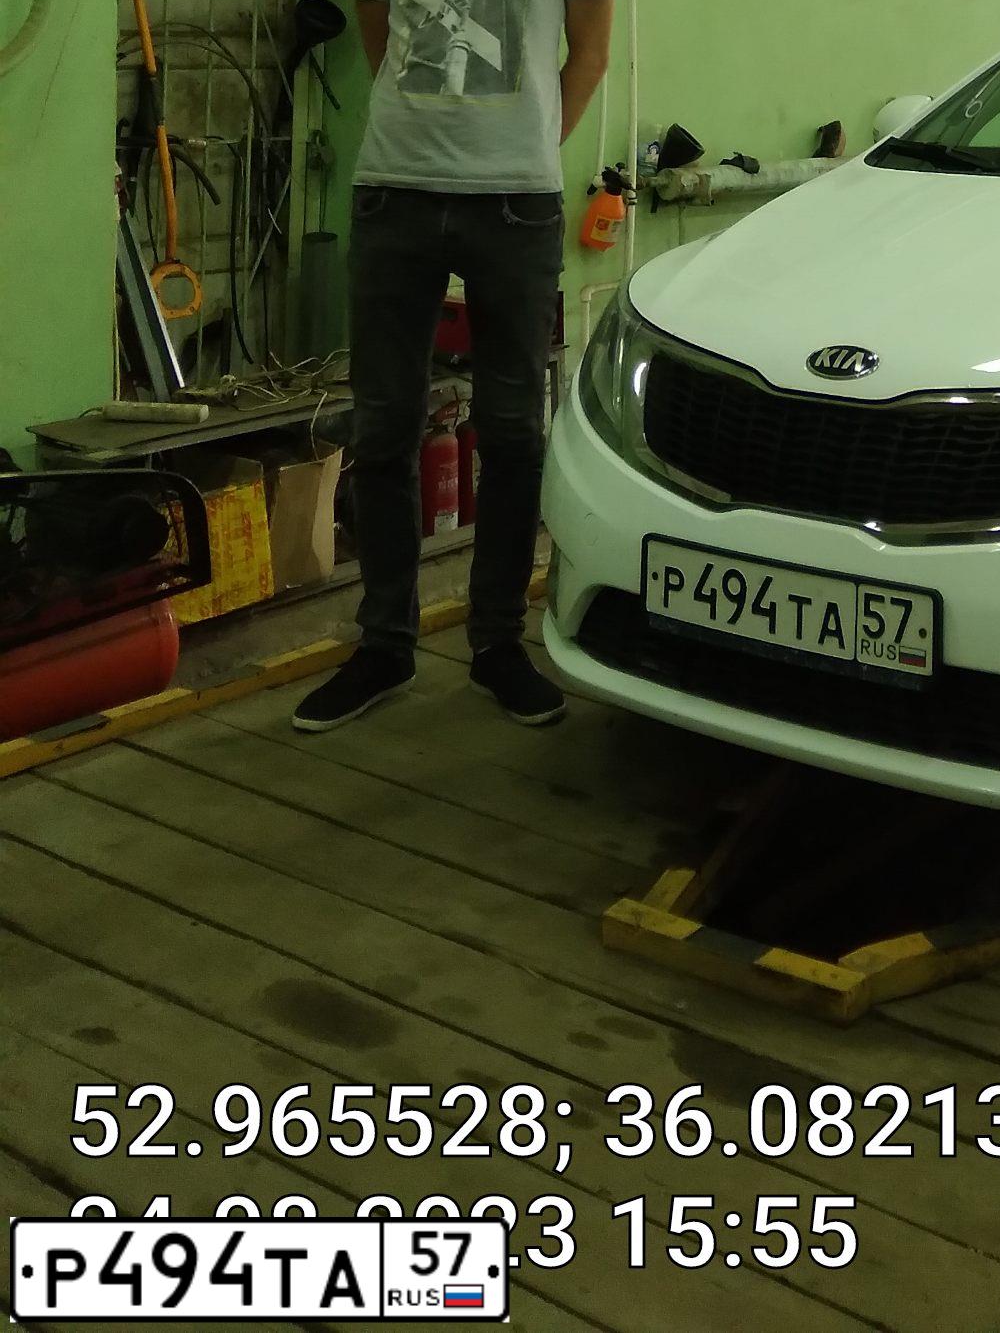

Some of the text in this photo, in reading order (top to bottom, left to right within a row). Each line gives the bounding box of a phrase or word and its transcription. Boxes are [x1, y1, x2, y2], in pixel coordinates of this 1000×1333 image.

[814, 347, 866, 373] KIA
[862, 591, 914, 645] 57
[859, 638, 898, 662] RUS
